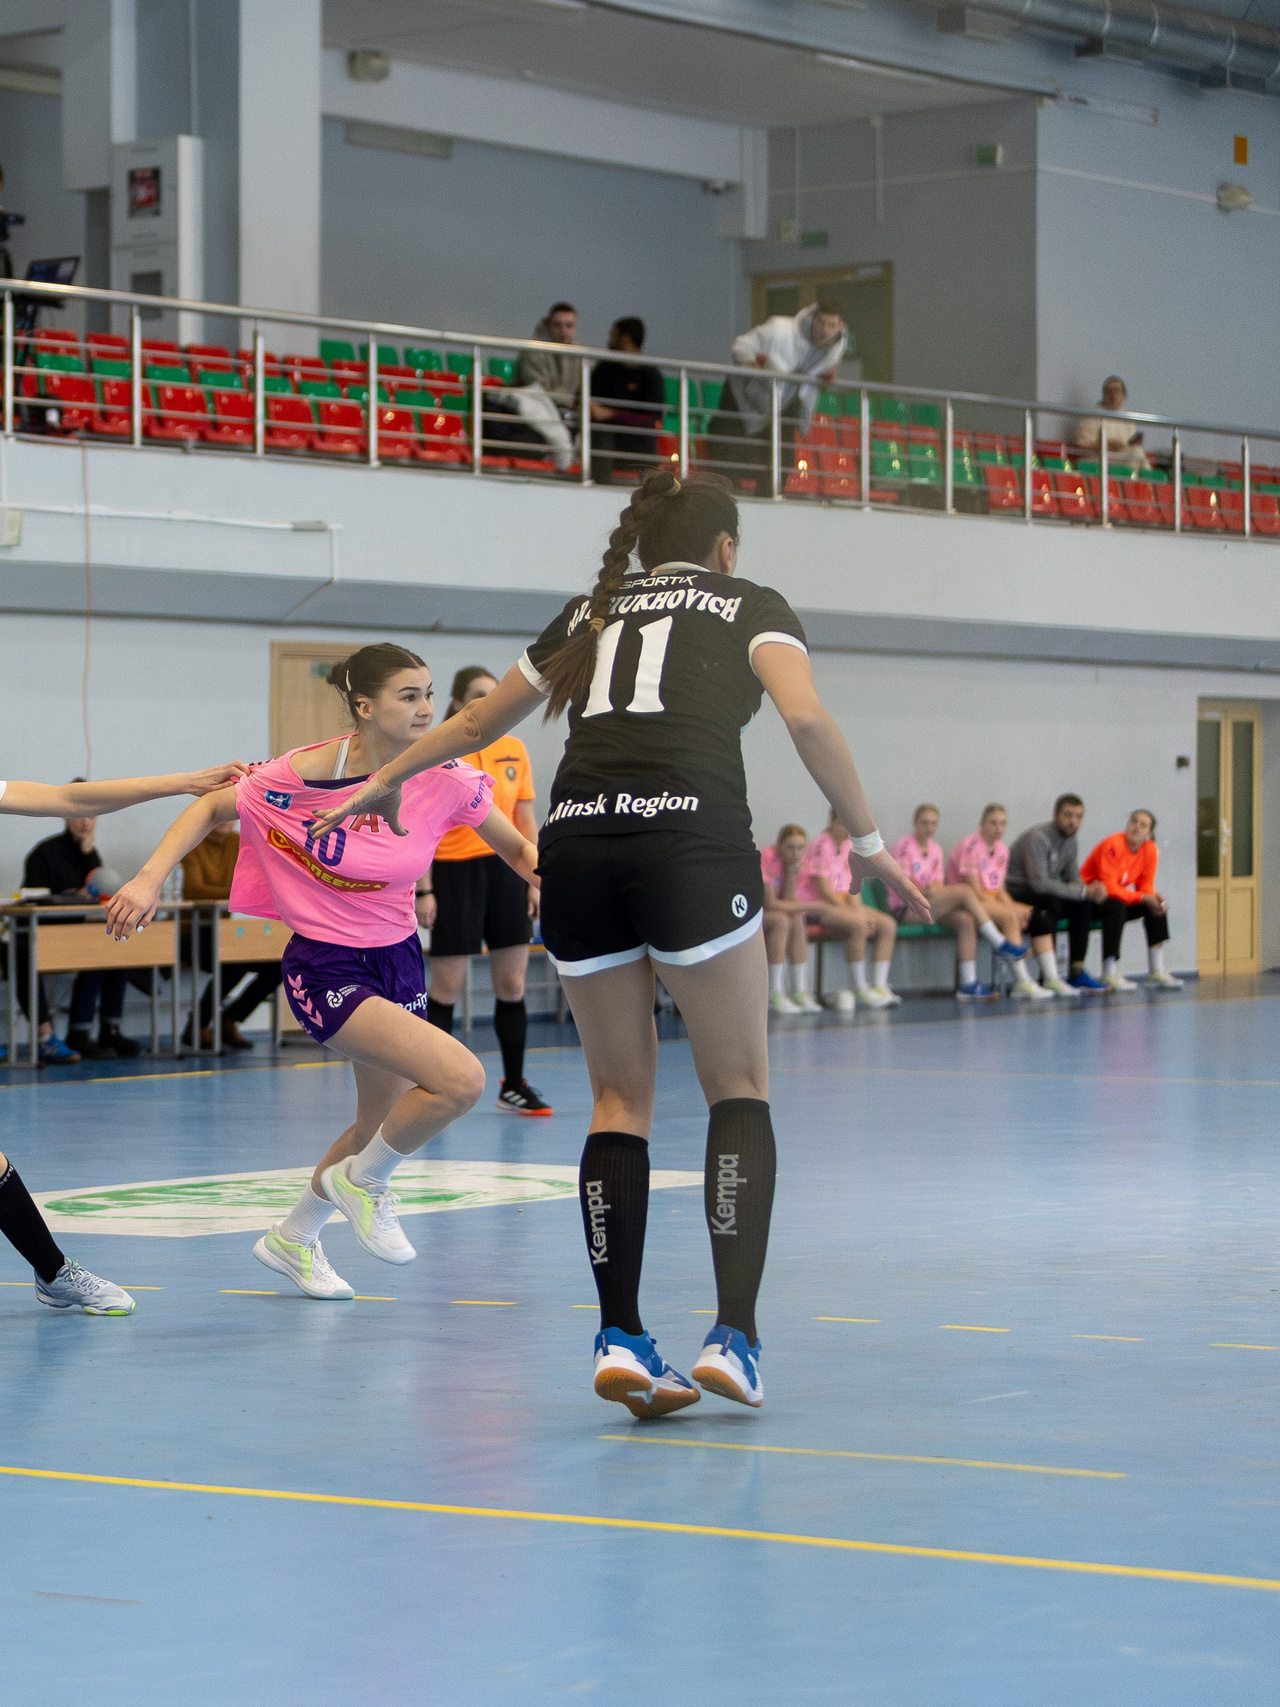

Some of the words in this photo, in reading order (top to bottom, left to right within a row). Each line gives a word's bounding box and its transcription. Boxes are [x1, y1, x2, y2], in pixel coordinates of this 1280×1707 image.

[618, 574, 698, 590] SPORTIX
[581, 615, 673, 718] 11
[545, 793, 608, 827] Minsk
[614, 791, 699, 818] Region
[301, 818, 347, 867] 10
[585, 1180, 612, 1266] Kempa
[710, 1153, 748, 1236] Kempa
